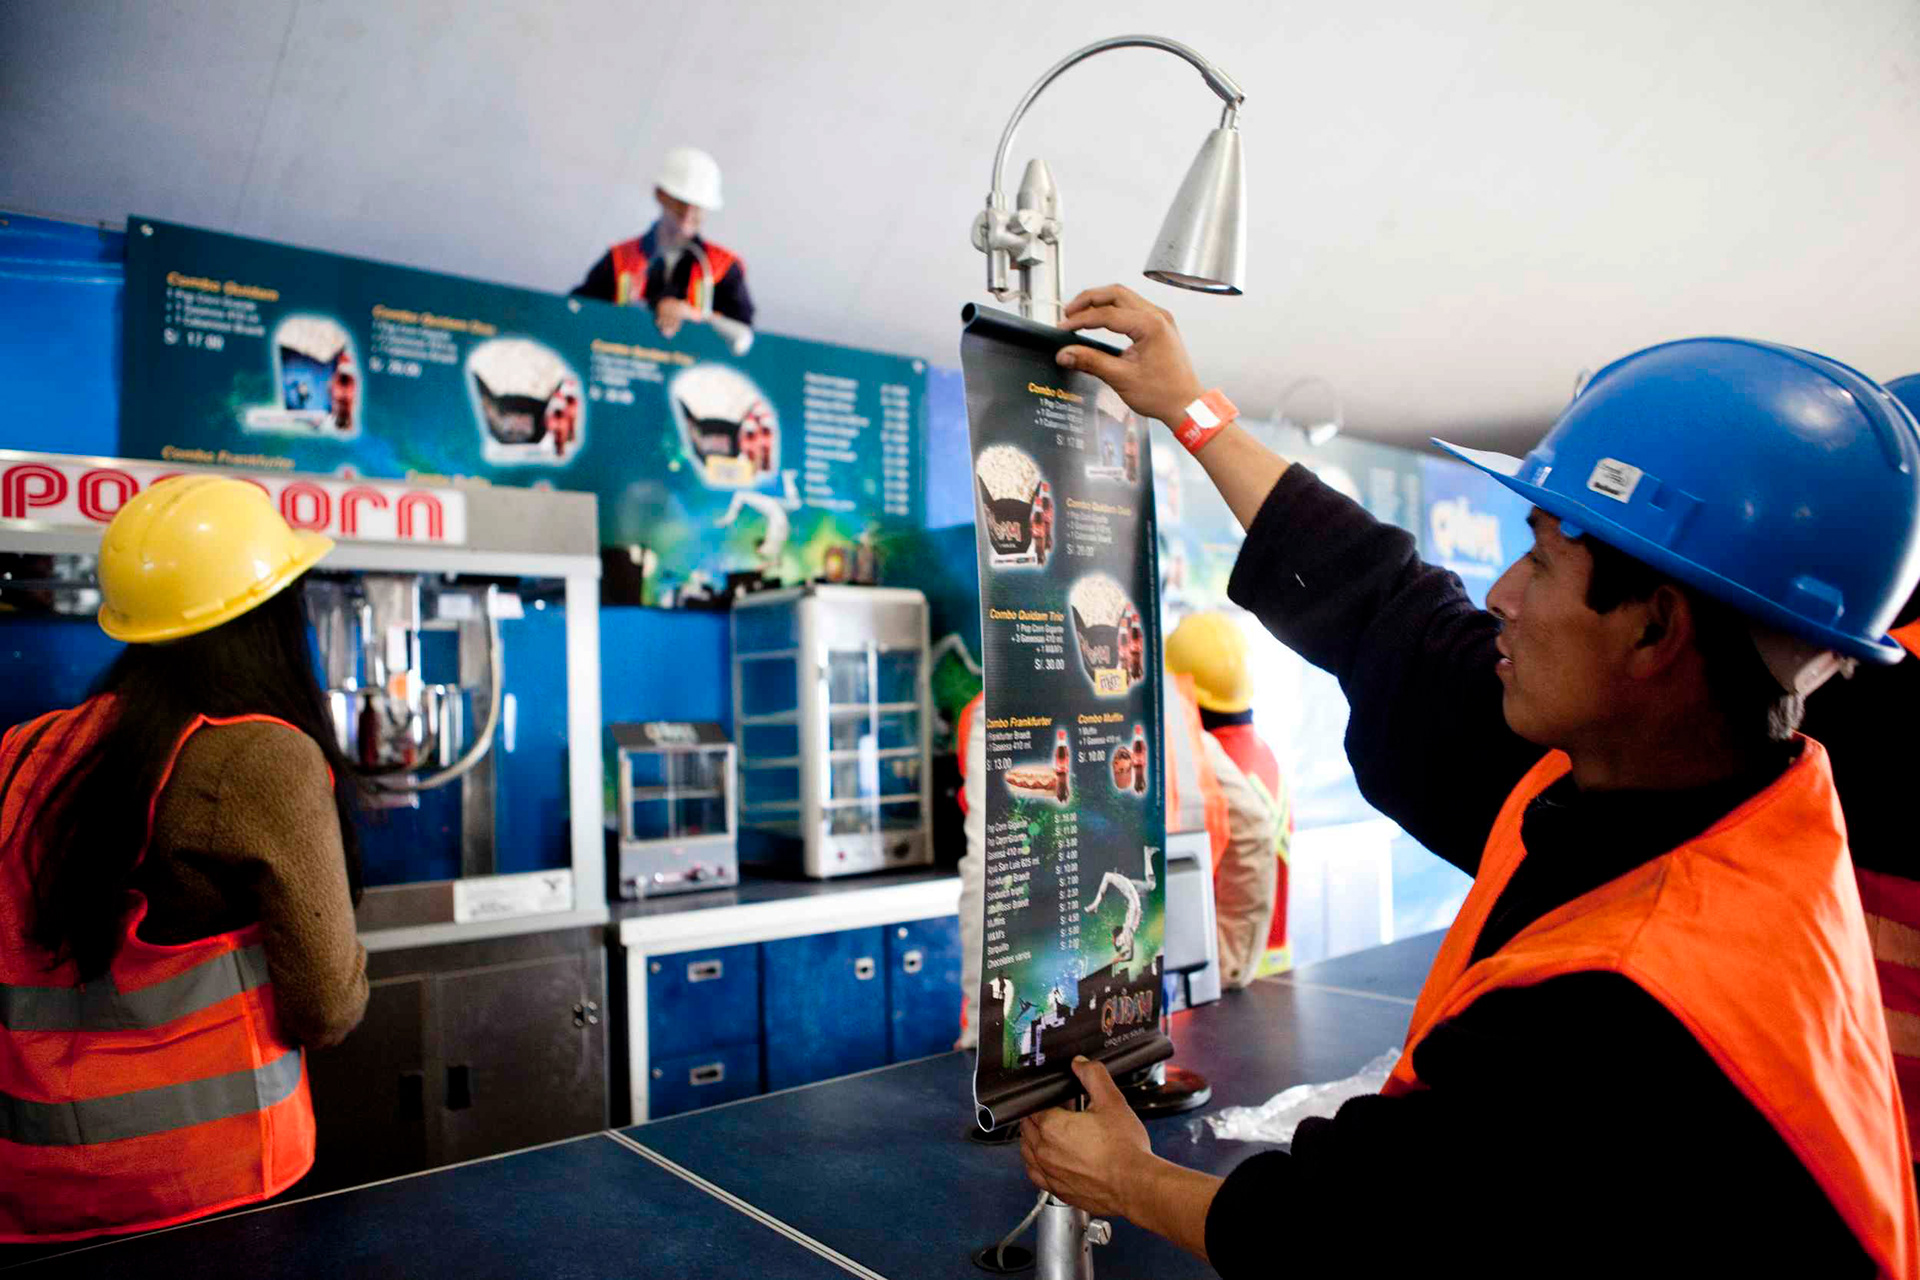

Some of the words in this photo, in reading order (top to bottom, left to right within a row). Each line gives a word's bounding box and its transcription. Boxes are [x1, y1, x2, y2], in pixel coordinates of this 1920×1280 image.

[1027, 382, 1056, 398] Combo
[989, 608, 1017, 621] Combo
[1018, 610, 1048, 622] Quidam
[1045, 658, 1065, 671] 30.00
[1010, 716, 1052, 728] Frankfurter
[1077, 713, 1103, 725] Combo
